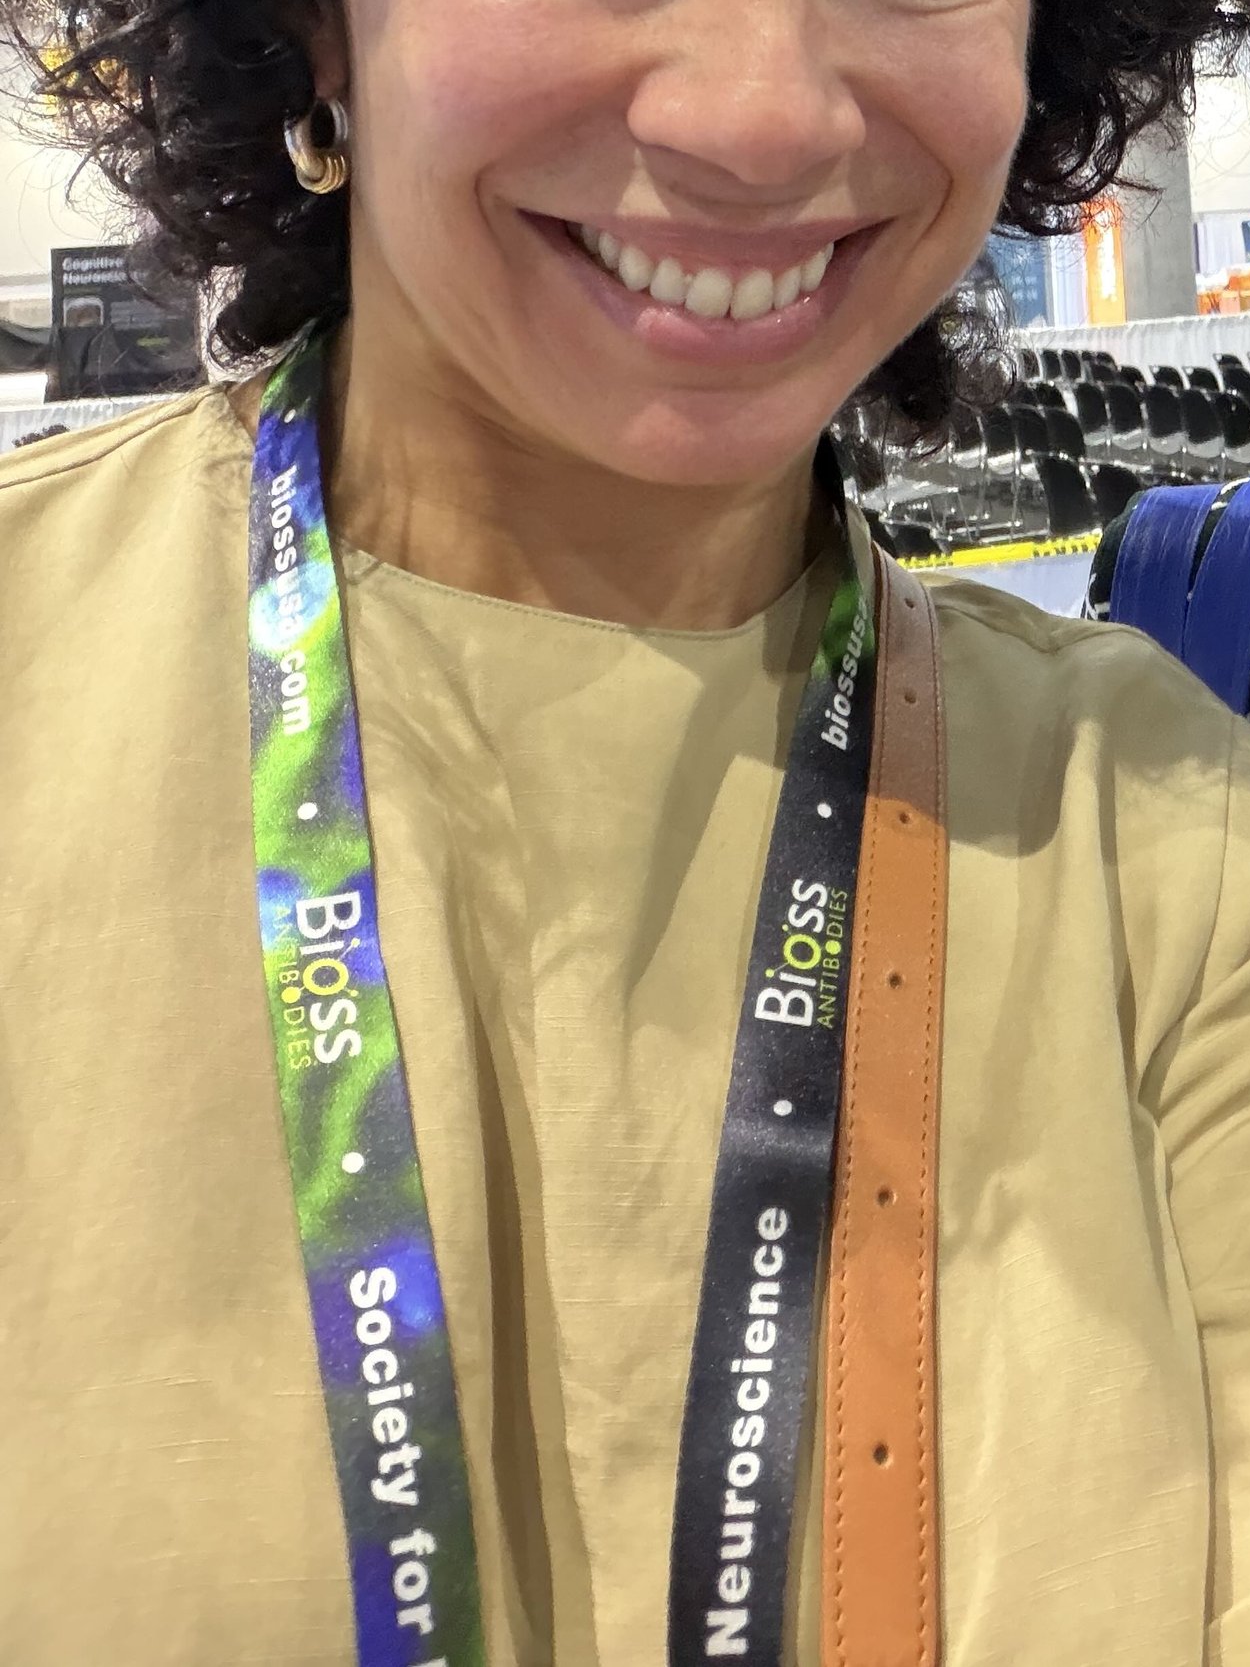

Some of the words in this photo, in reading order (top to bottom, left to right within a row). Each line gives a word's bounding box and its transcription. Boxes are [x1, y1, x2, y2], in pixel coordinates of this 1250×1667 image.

[817, 888, 848, 1029] ANTIBODIES
[349, 1265, 422, 1508] Society
[389, 1528, 437, 1635] for
[705, 1205, 790, 1659] Neuroscience
